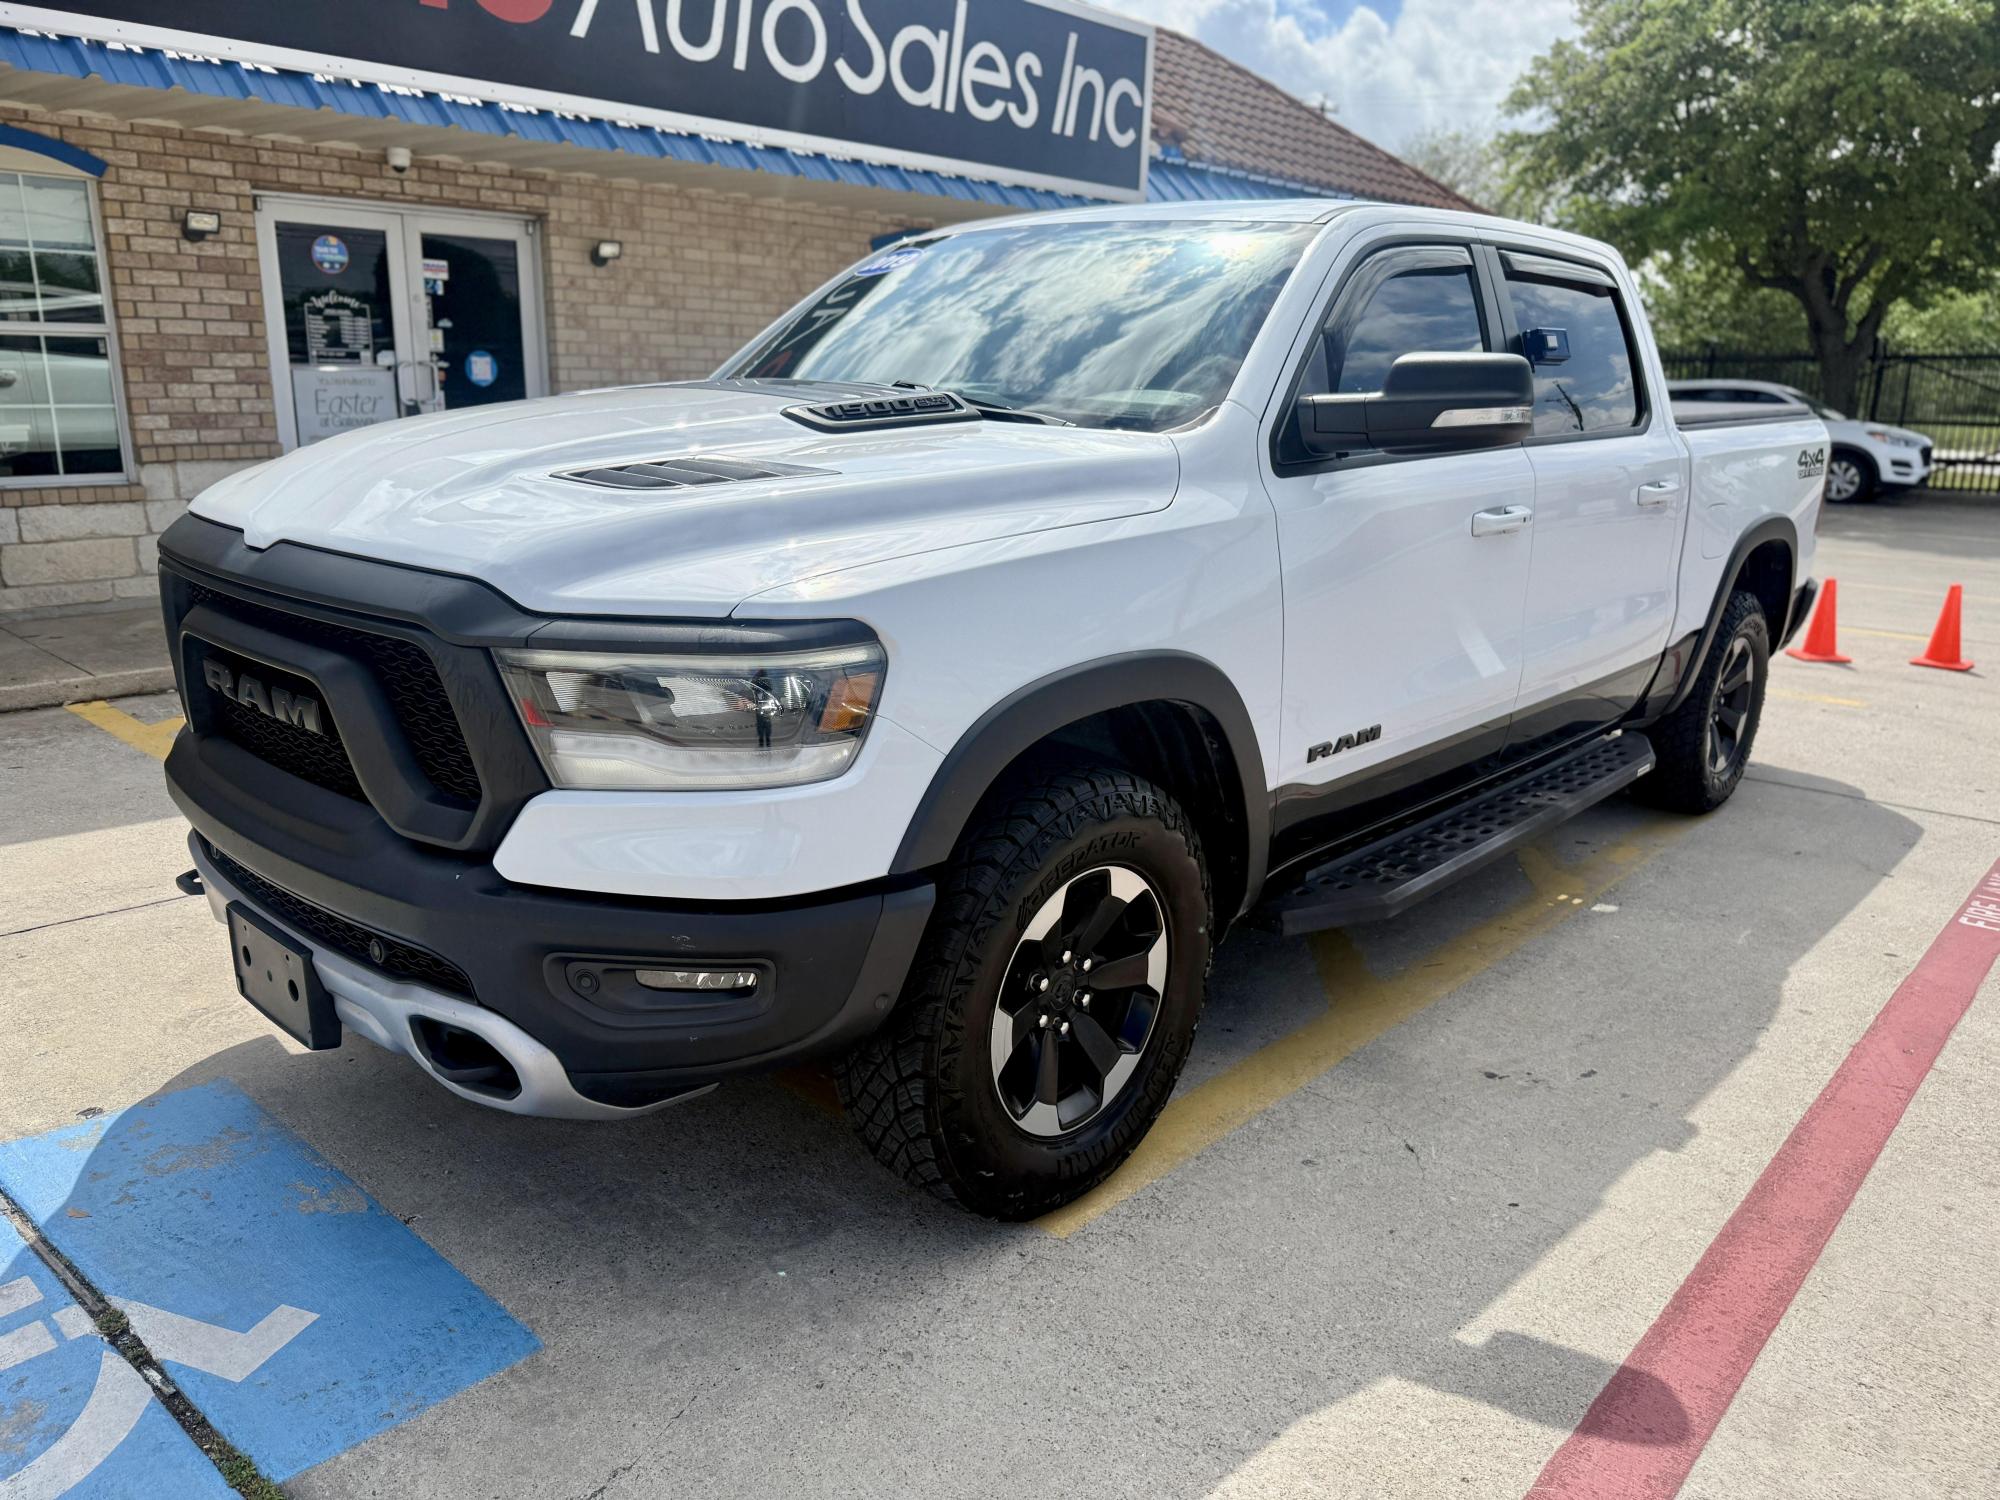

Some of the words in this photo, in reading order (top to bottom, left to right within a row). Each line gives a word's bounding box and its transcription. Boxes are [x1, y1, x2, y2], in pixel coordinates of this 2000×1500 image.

[1051, 31, 1143, 148] Inc
[314, 388, 384, 417] Easter
[825, 398, 915, 419] 1500
[203, 657, 324, 736] RAM
[1306, 723, 1382, 764] RAM
